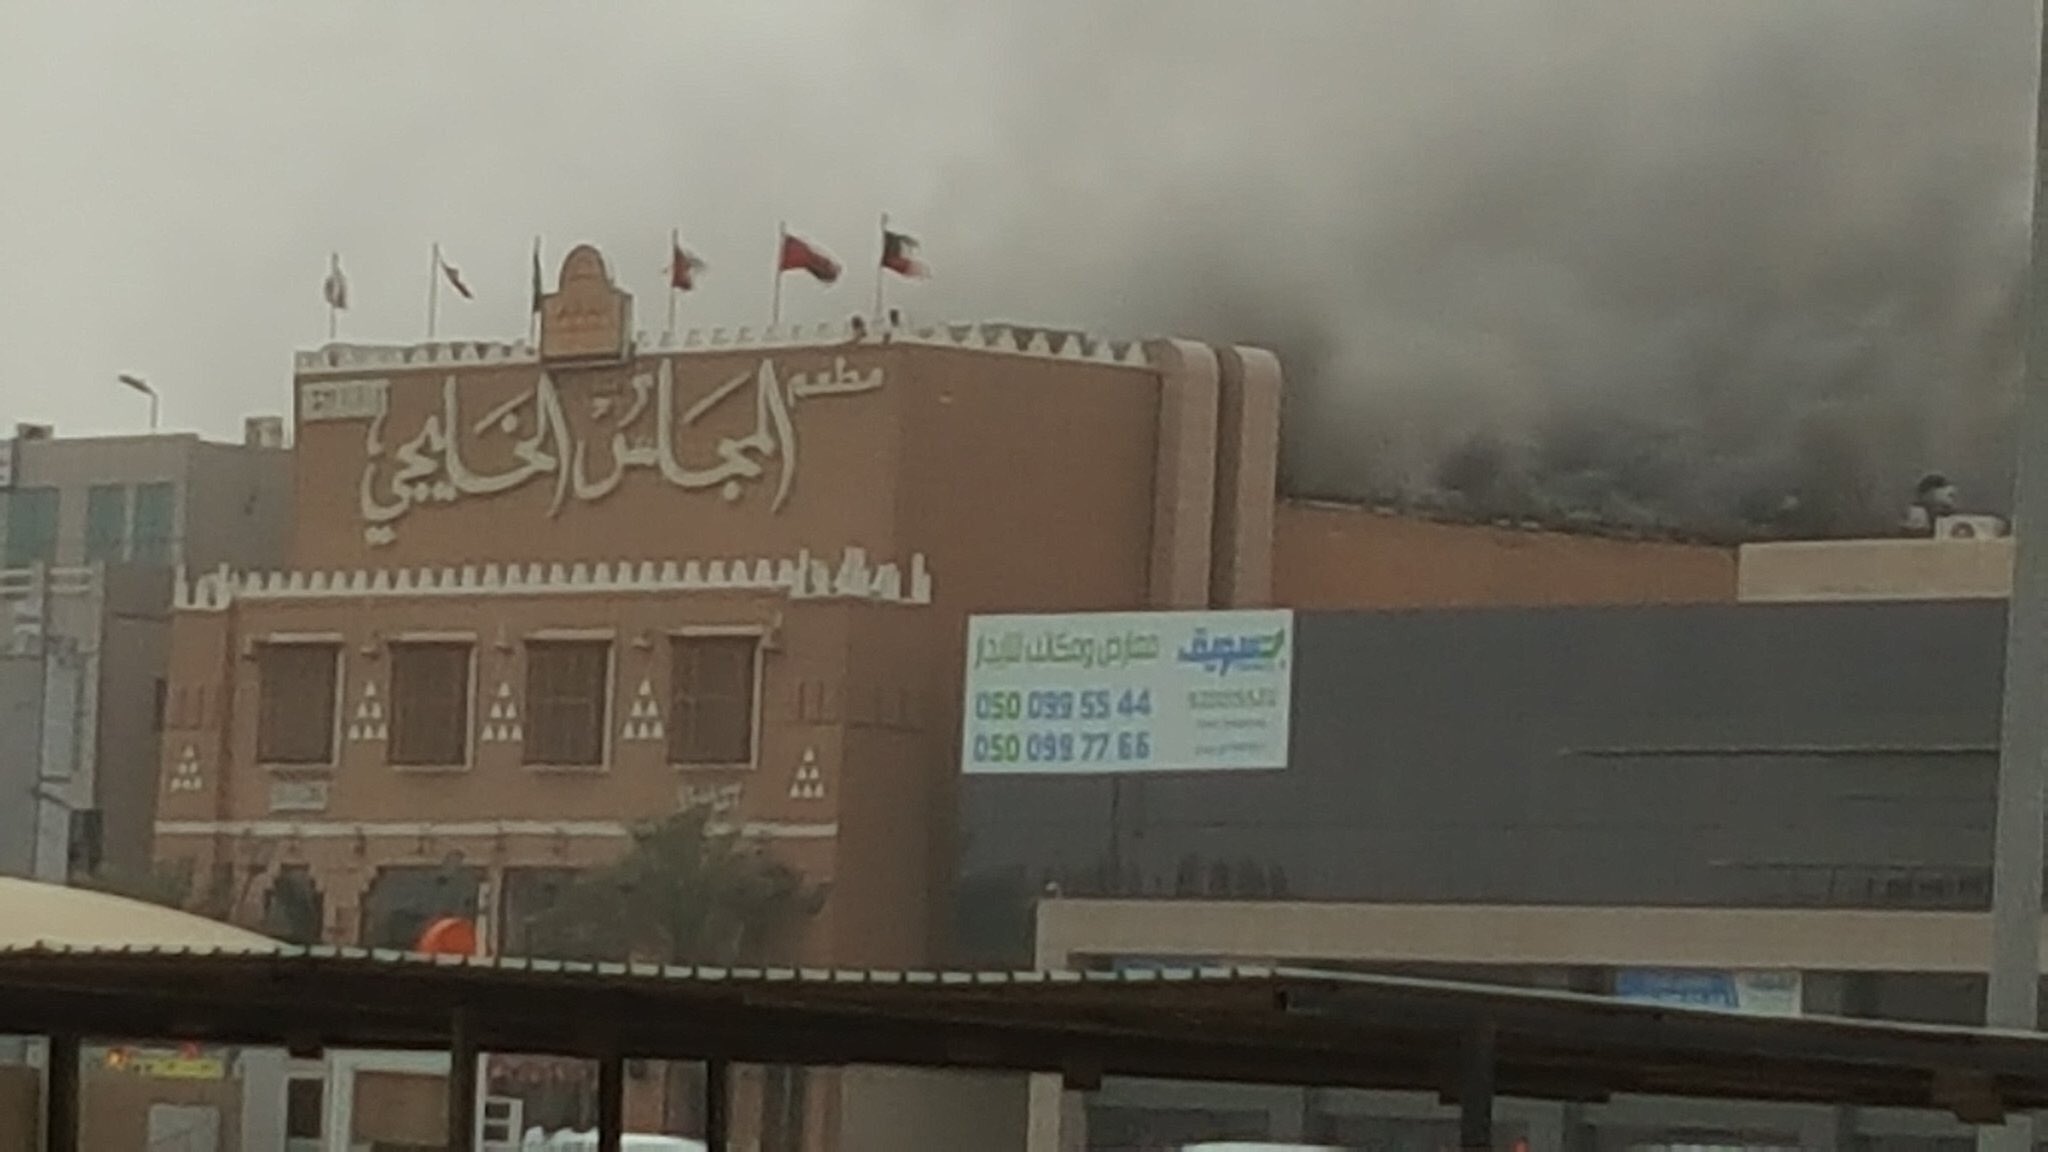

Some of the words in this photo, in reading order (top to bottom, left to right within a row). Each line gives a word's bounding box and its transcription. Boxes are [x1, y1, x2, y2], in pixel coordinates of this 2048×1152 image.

[787, 354, 883, 407] مطعم
[360, 372, 570, 544] الخليجي
[975, 691, 1021, 719] 050
[1080, 689, 1110, 718] 55
[1117, 687, 1151, 714] 44
[973, 733, 1020, 762] 050
[1081, 732, 1109, 760] 77
[1117, 731, 1150, 760] 66
